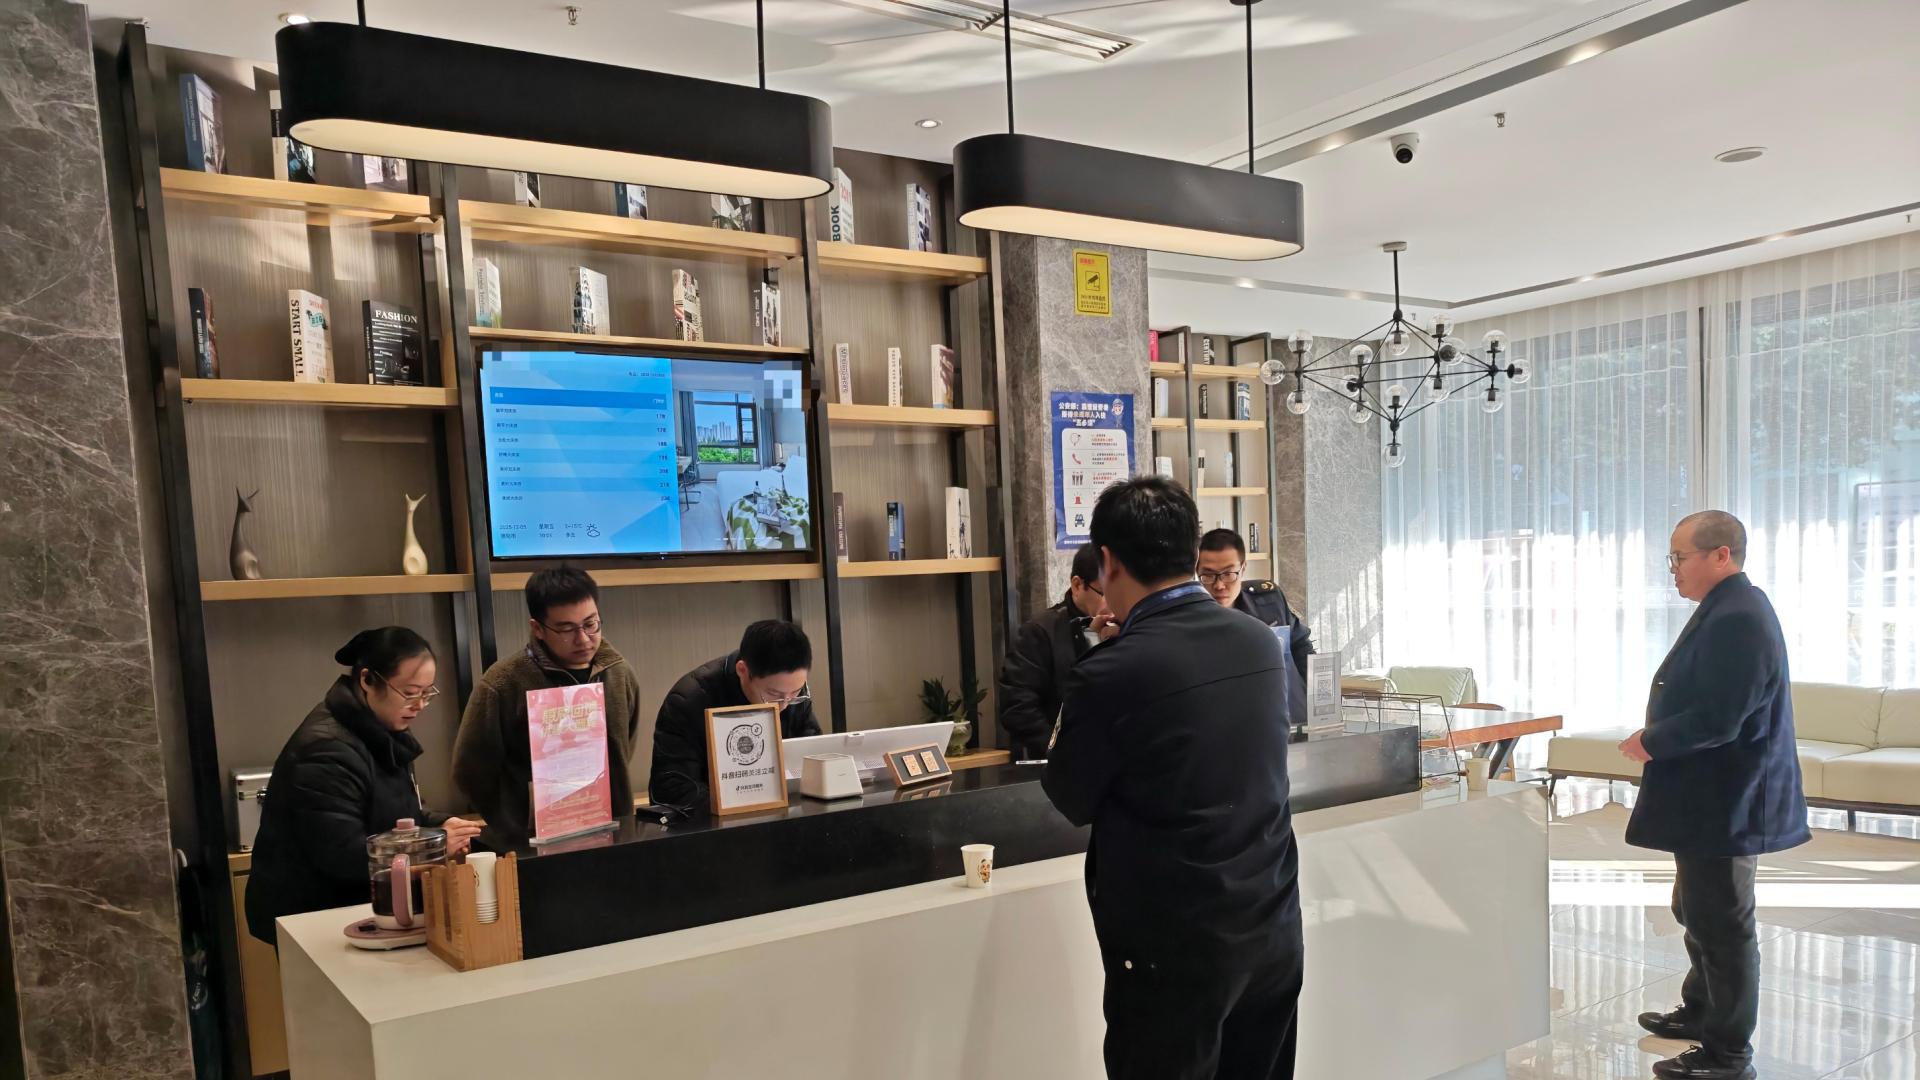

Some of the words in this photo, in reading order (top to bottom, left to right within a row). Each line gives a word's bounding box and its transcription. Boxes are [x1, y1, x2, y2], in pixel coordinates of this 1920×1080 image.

[831, 205, 841, 242] BOOK
[290, 299, 301, 335] START
[375, 309, 419, 323] FASHION
[293, 338, 304, 377] SMALL
